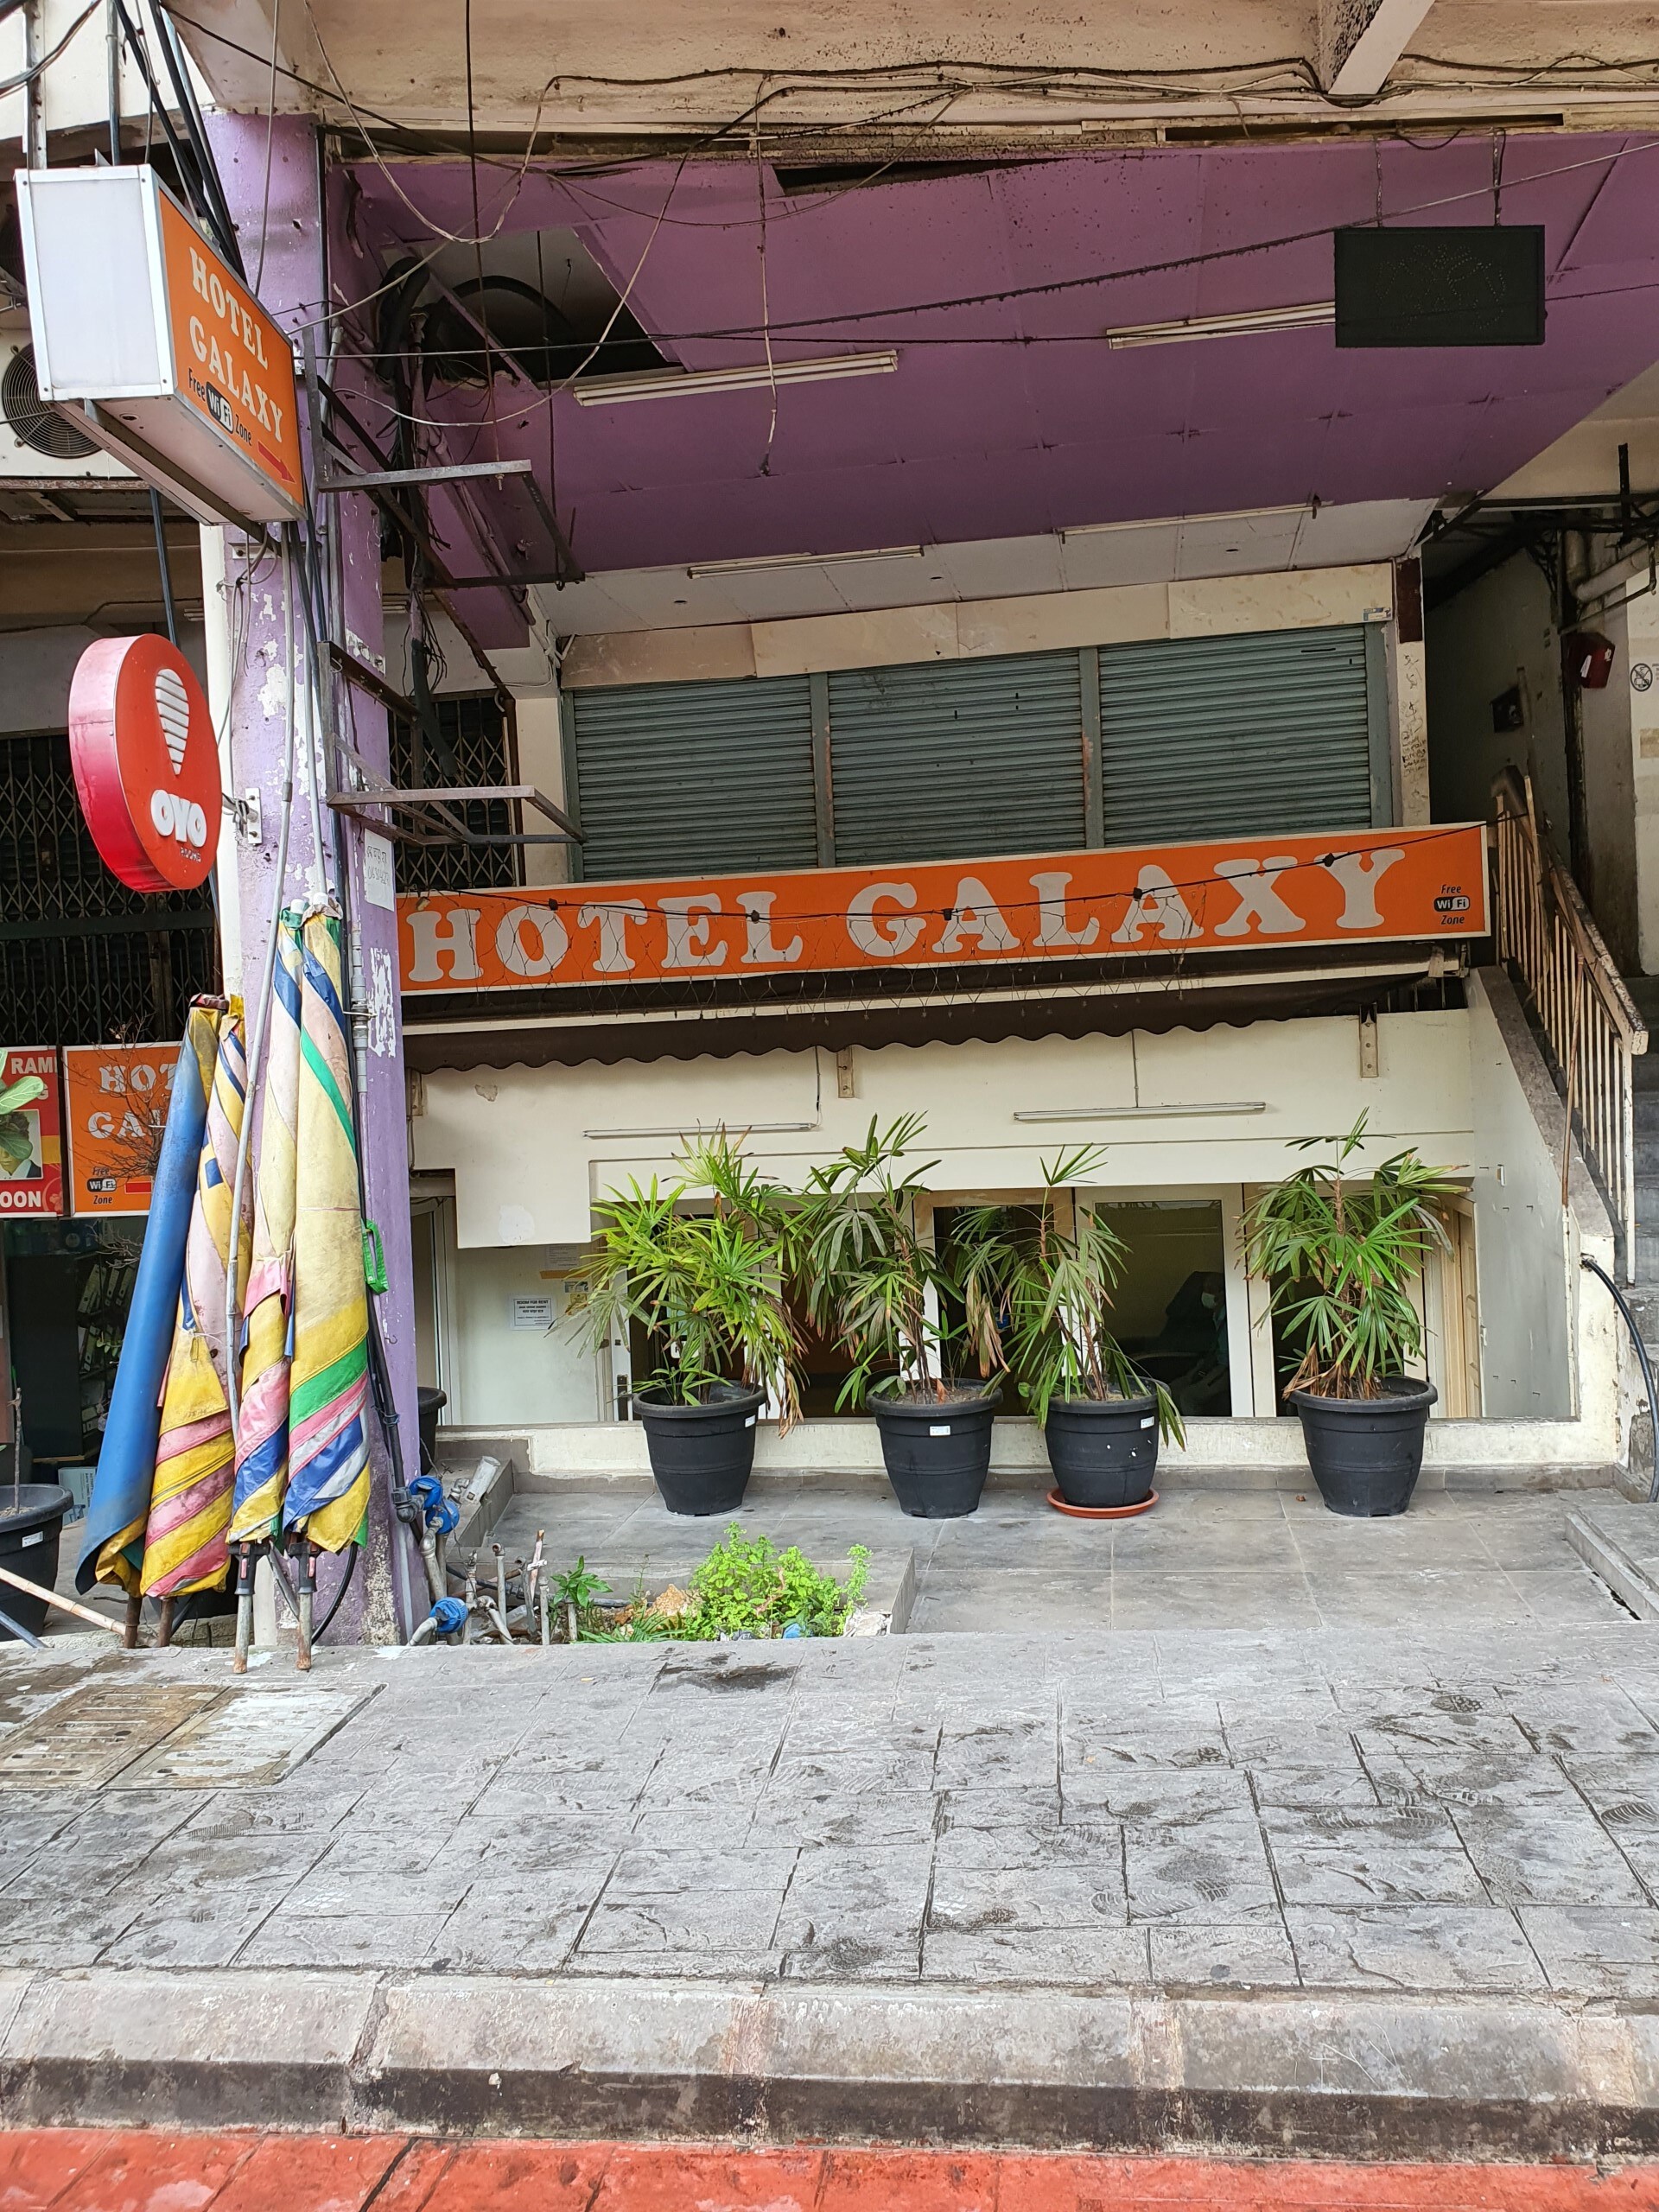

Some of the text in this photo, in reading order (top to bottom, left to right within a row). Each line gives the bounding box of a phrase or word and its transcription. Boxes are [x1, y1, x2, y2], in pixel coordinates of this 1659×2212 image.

[189, 246, 269, 370] HOTEL
[188, 315, 283, 443] GALAXY
[188, 367, 207, 404] Free
[234, 413, 252, 447] Zone
[150, 789, 207, 848] OYO
[406, 848, 1407, 983] HOTEL GALAXY
[1440, 883, 1462, 894] Free
[1440, 914, 1465, 925] Zone
[92, 1166, 110, 1176] Free
[92, 1195, 113, 1205] Zone
